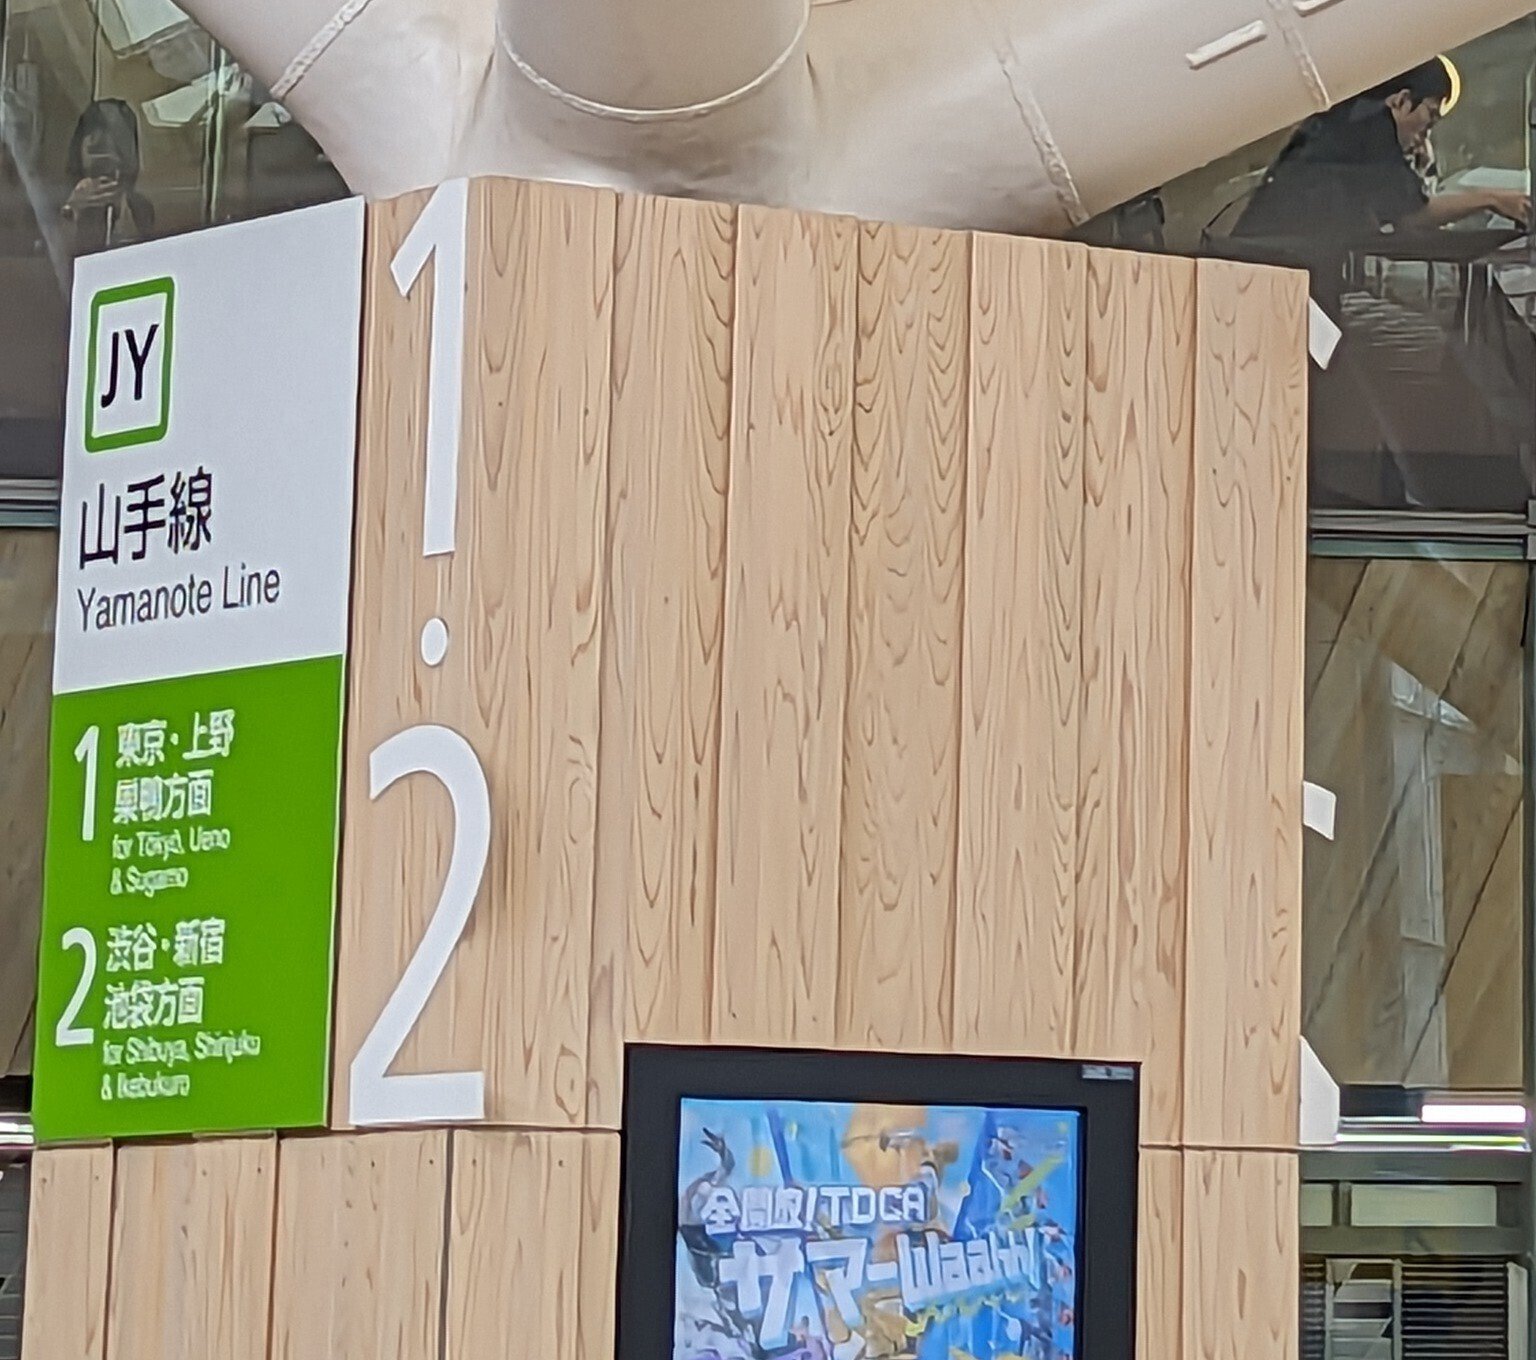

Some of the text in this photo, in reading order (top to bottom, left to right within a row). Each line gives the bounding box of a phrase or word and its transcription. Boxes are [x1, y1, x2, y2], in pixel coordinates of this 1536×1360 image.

[100, 324, 160, 408] JY
[78, 466, 213, 570] 山手線
[77, 563, 280, 632] Yamanote Line
[74, 725, 99, 842] 1
[55, 927, 96, 1047] 2
